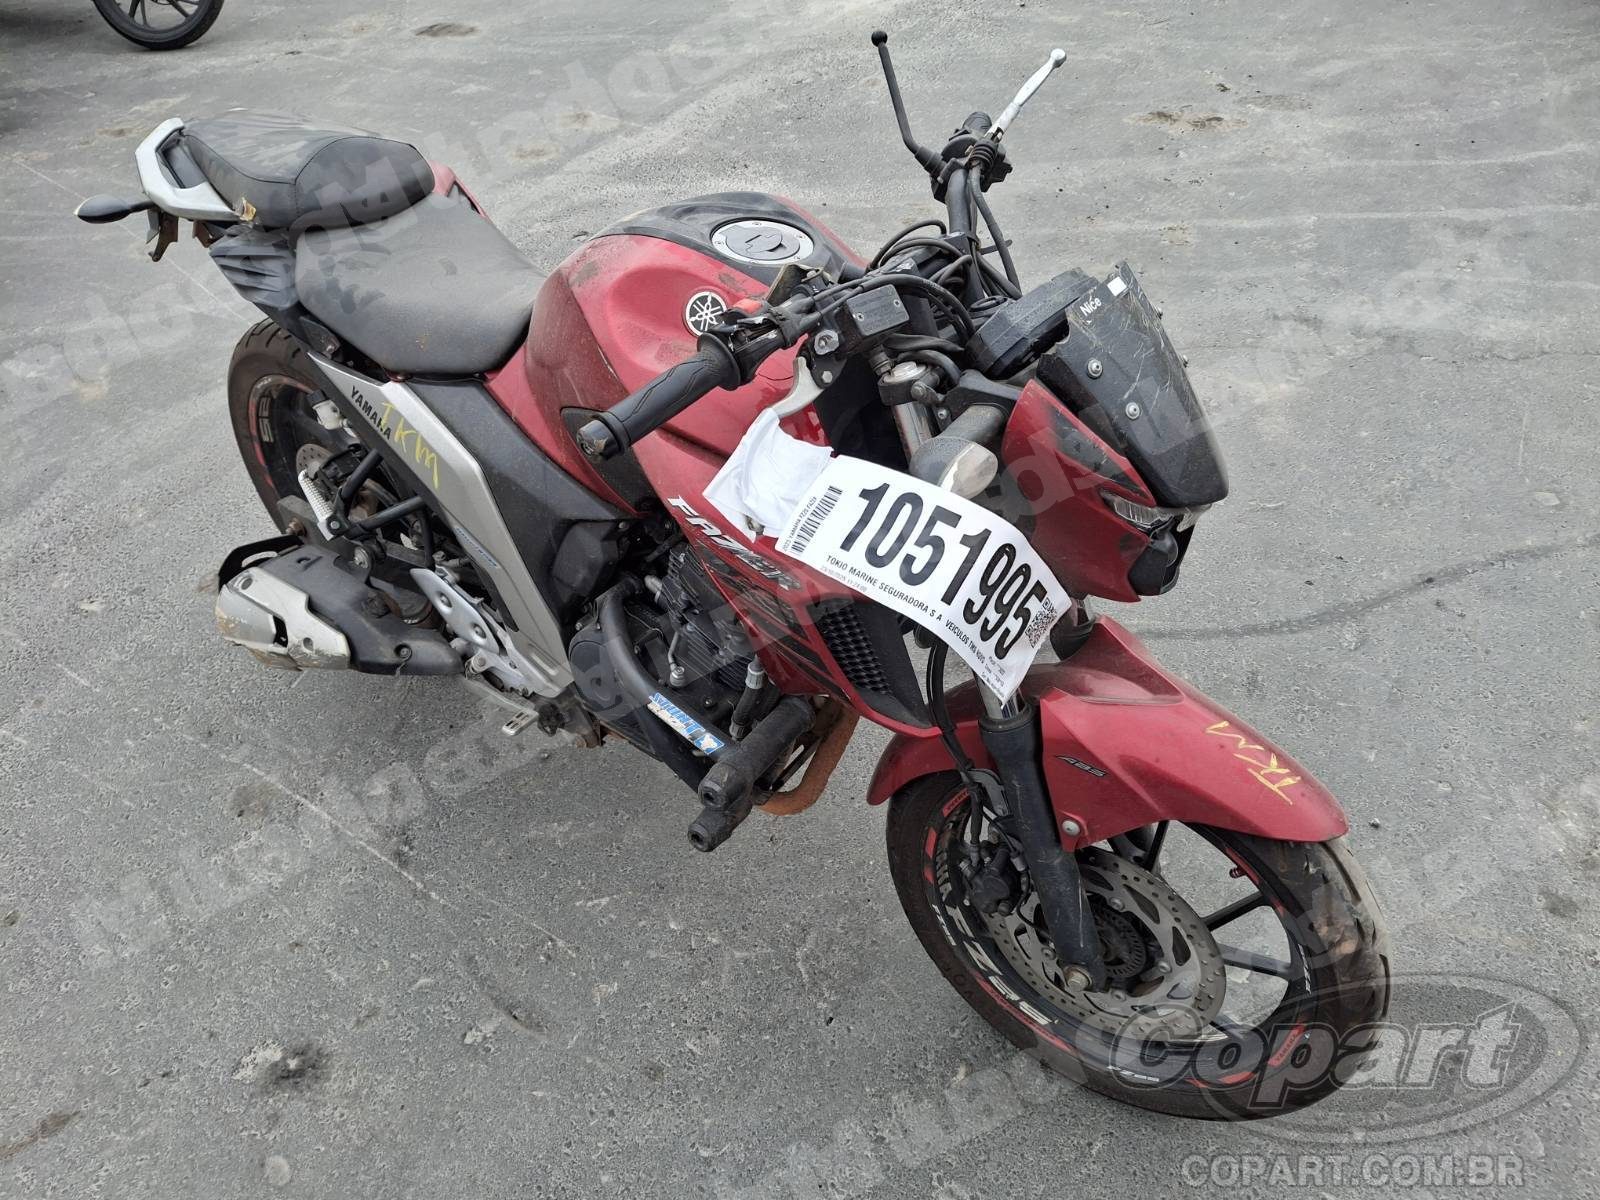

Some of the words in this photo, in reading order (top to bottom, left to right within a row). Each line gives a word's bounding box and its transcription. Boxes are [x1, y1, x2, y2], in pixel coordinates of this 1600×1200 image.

[1079, 297, 1102, 317] Nice
[351, 385, 392, 441] YAMAHA
[840, 482, 1048, 660] 1051995
[848, 566, 880, 587] MARINE
[879, 582, 928, 613] SEGURADORA
[929, 609, 937, 617] S
[945, 619, 970, 645] VEICULOS
